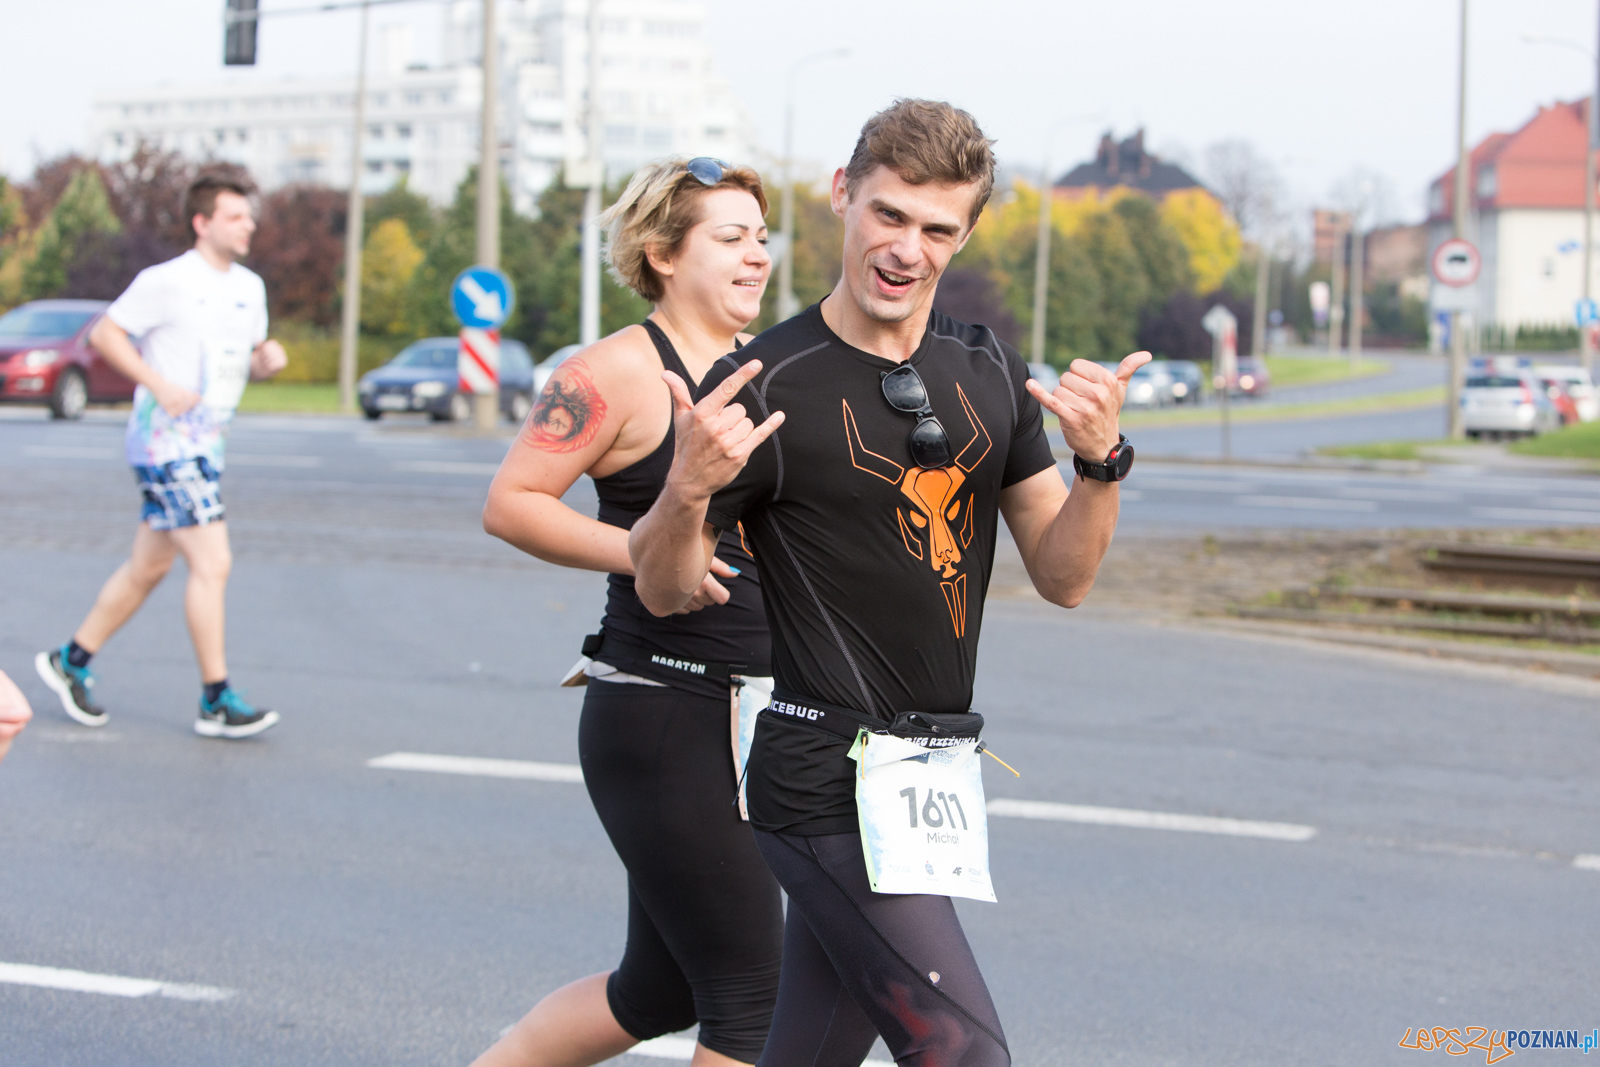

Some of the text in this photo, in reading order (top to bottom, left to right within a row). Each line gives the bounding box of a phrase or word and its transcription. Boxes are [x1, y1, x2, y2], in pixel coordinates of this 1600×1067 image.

[651, 654, 706, 675] MARATON
[899, 787, 968, 831] 1611
[952, 866, 963, 876] 4F
